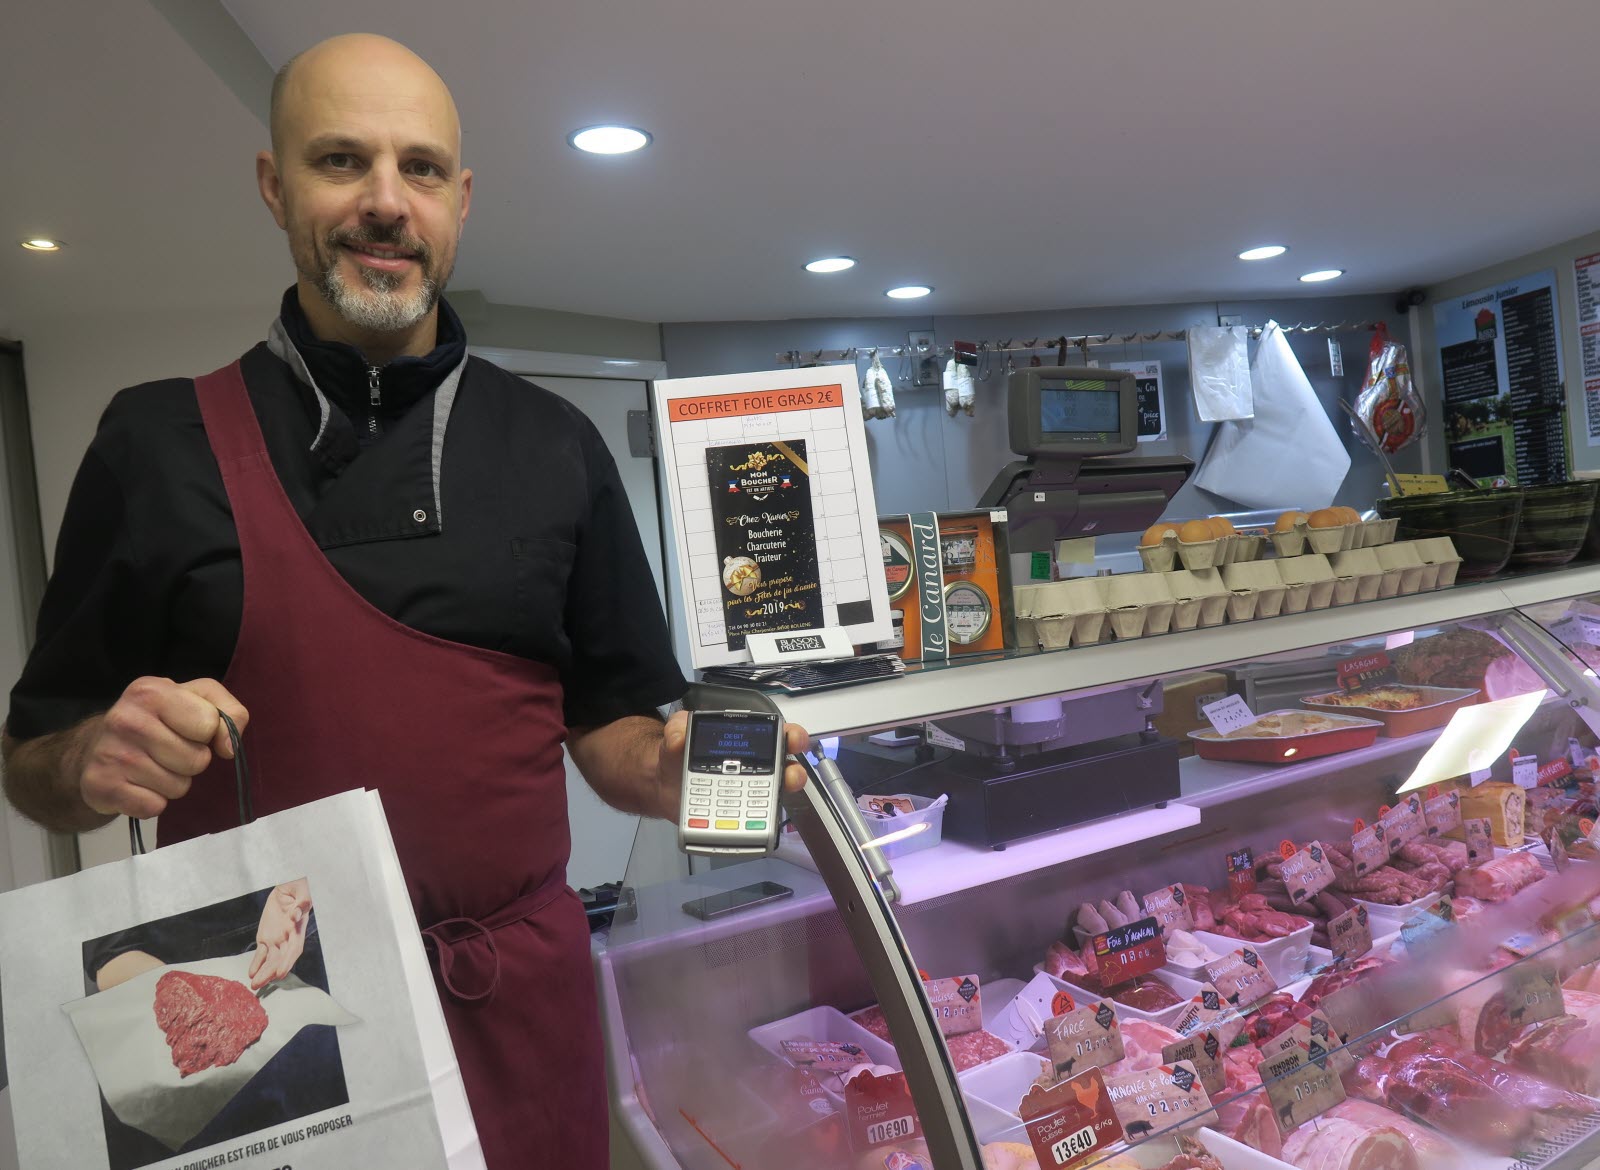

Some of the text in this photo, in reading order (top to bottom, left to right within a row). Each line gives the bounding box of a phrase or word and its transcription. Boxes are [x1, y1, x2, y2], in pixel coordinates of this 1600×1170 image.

[1462, 286, 1520, 310] Limousin Junior
[679, 390, 834, 416] COFFRET FOIE GRAS 2€
[741, 476, 778, 487] BOUCHER
[750, 471, 768, 479] MON
[738, 511, 788, 527] Chez Xavier
[747, 527, 783, 540] Boucherie
[746, 539, 787, 552] Charcuterie
[753, 552, 782, 563] Traiteur
[913, 522, 945, 654] le Canard
[762, 601, 785, 615] 2019
[1344, 657, 1379, 673] LASAGNE
[1052, 1016, 1086, 1041] FARCE
[1268, 1054, 1301, 1075] TENDRON
[1106, 1079, 1147, 1103] ARAIGNÉE
[857, 1101, 889, 1116] Poulet
[858, 1110, 888, 1121] fermier
[869, 1118, 909, 1143] 10€90
[1036, 1115, 1067, 1137] Poulet
[227, 1147, 245, 1164] EST
[245, 1141, 267, 1158] FIER
[267, 1136, 280, 1151] DE
[280, 1129, 306, 1148] VOUS
[306, 1114, 353, 1139] PROPOSER
[1041, 1127, 1064, 1143] cuisse
[1054, 1128, 1093, 1163] 13€40
